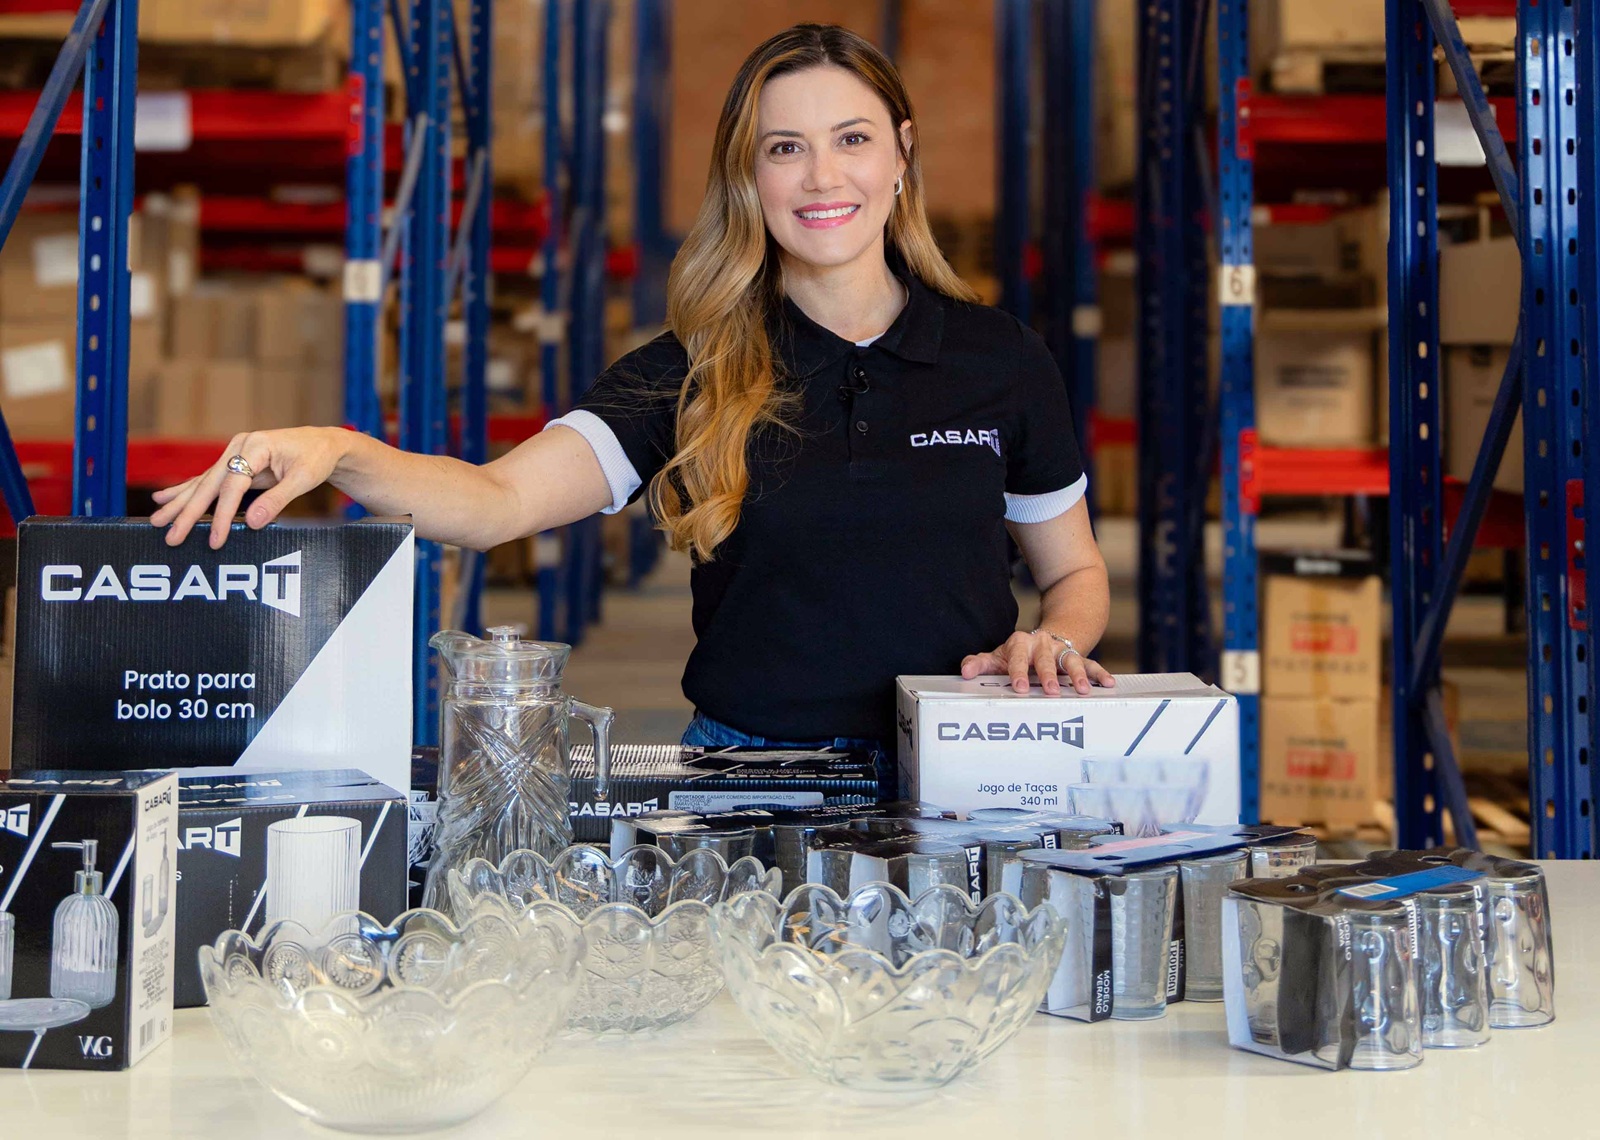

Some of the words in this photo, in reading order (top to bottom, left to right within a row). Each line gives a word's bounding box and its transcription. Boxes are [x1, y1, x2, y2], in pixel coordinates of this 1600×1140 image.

[1230, 267, 1243, 297] 6
[910, 429, 1001, 457] CASART
[41, 550, 301, 617] CASART
[124, 669, 191, 690] Prato
[197, 673, 256, 695] para
[1234, 655, 1247, 685] 5
[117, 698, 172, 720] bolo
[178, 699, 209, 719] 30
[215, 702, 255, 719] cm
[937, 715, 1084, 749] CASART
[977, 783, 1005, 795] Jogo
[1007, 783, 1022, 793] de
[1025, 783, 1058, 795] Taças
[1020, 796, 1041, 806] 340
[1043, 795, 1058, 806] ml
[176, 817, 242, 858] RT
[1340, 914, 1352, 961] MODELO
[1167, 943, 1178, 995] TROPICAL
[1095, 973, 1104, 1014] VERANO
[1103, 970, 1111, 1013] MODELO
[78, 1035, 113, 1056] WG
